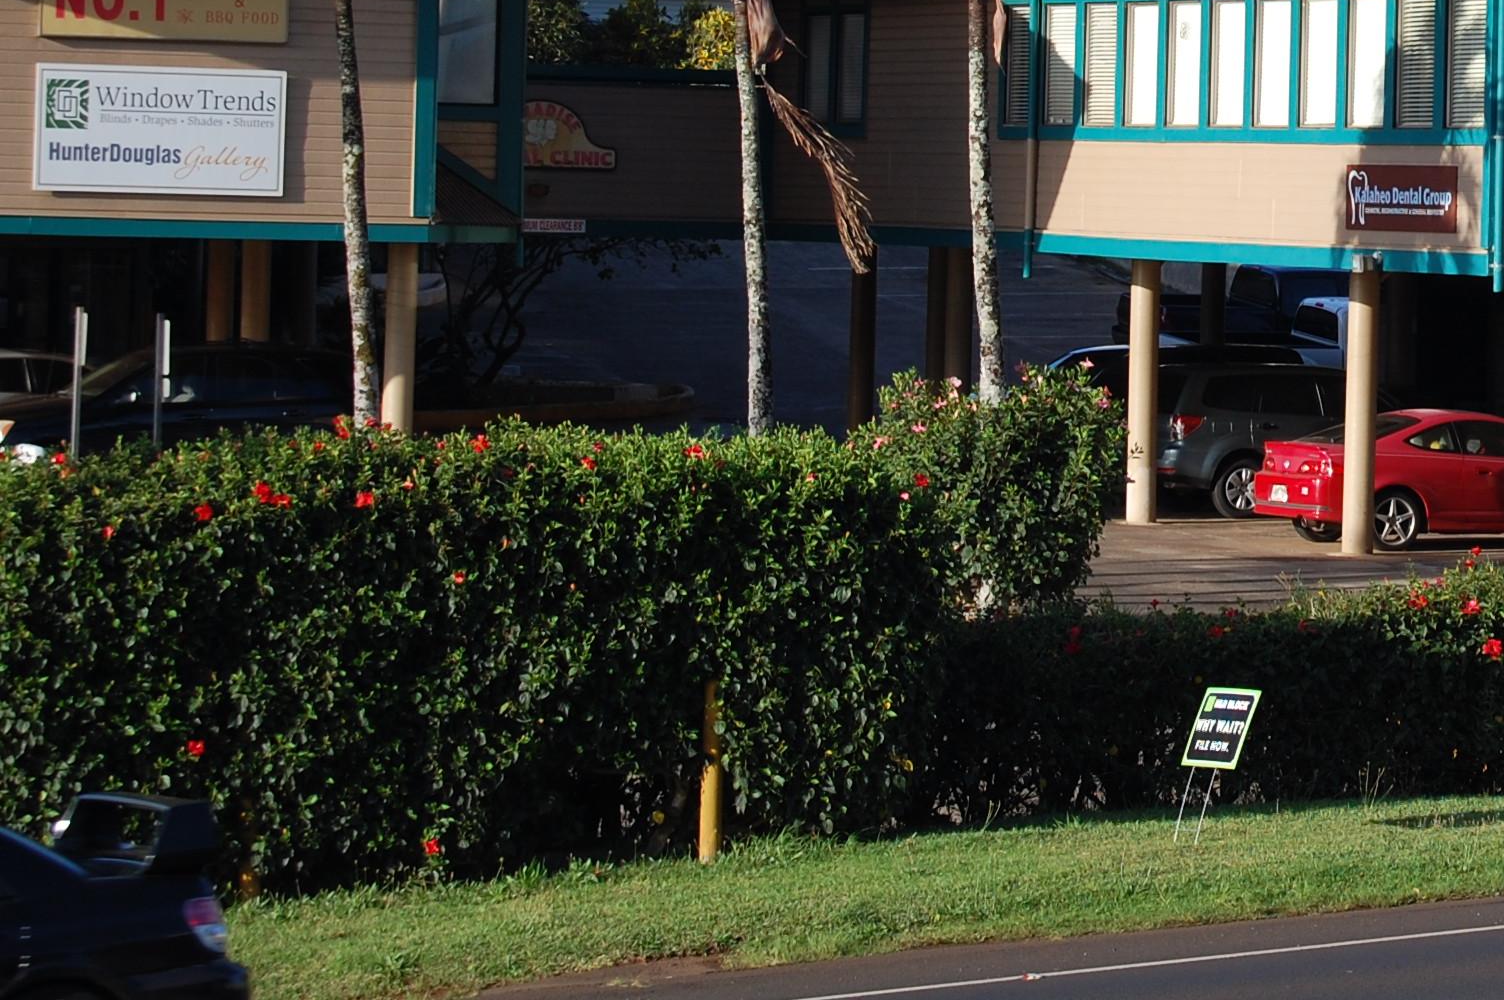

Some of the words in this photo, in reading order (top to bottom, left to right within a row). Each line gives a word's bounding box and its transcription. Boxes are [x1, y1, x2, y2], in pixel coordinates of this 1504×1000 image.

[205, 10, 234, 25] BBQ
[241, 11, 280, 26] FOOD
[96, 86, 194, 111] Window
[197, 89, 277, 112] Trends
[100, 114, 132, 125] Blinds
[142, 115, 178, 128] Drapes
[187, 116, 223, 128] Shades
[233, 118, 275, 129] Shutters
[49, 142, 182, 166] HunterDouglas
[174, 145, 269, 182] Gallery
[550, 150, 613, 167] CLINIC
[1354, 185, 1391, 204] Kalaheo
[1392, 186, 1422, 206] Dental
[1423, 188, 1452, 211] Group
[1195, 718, 1217, 733] WHY
[1215, 719, 1245, 736] WAIT?
[1194, 739, 1210, 751] FILE
